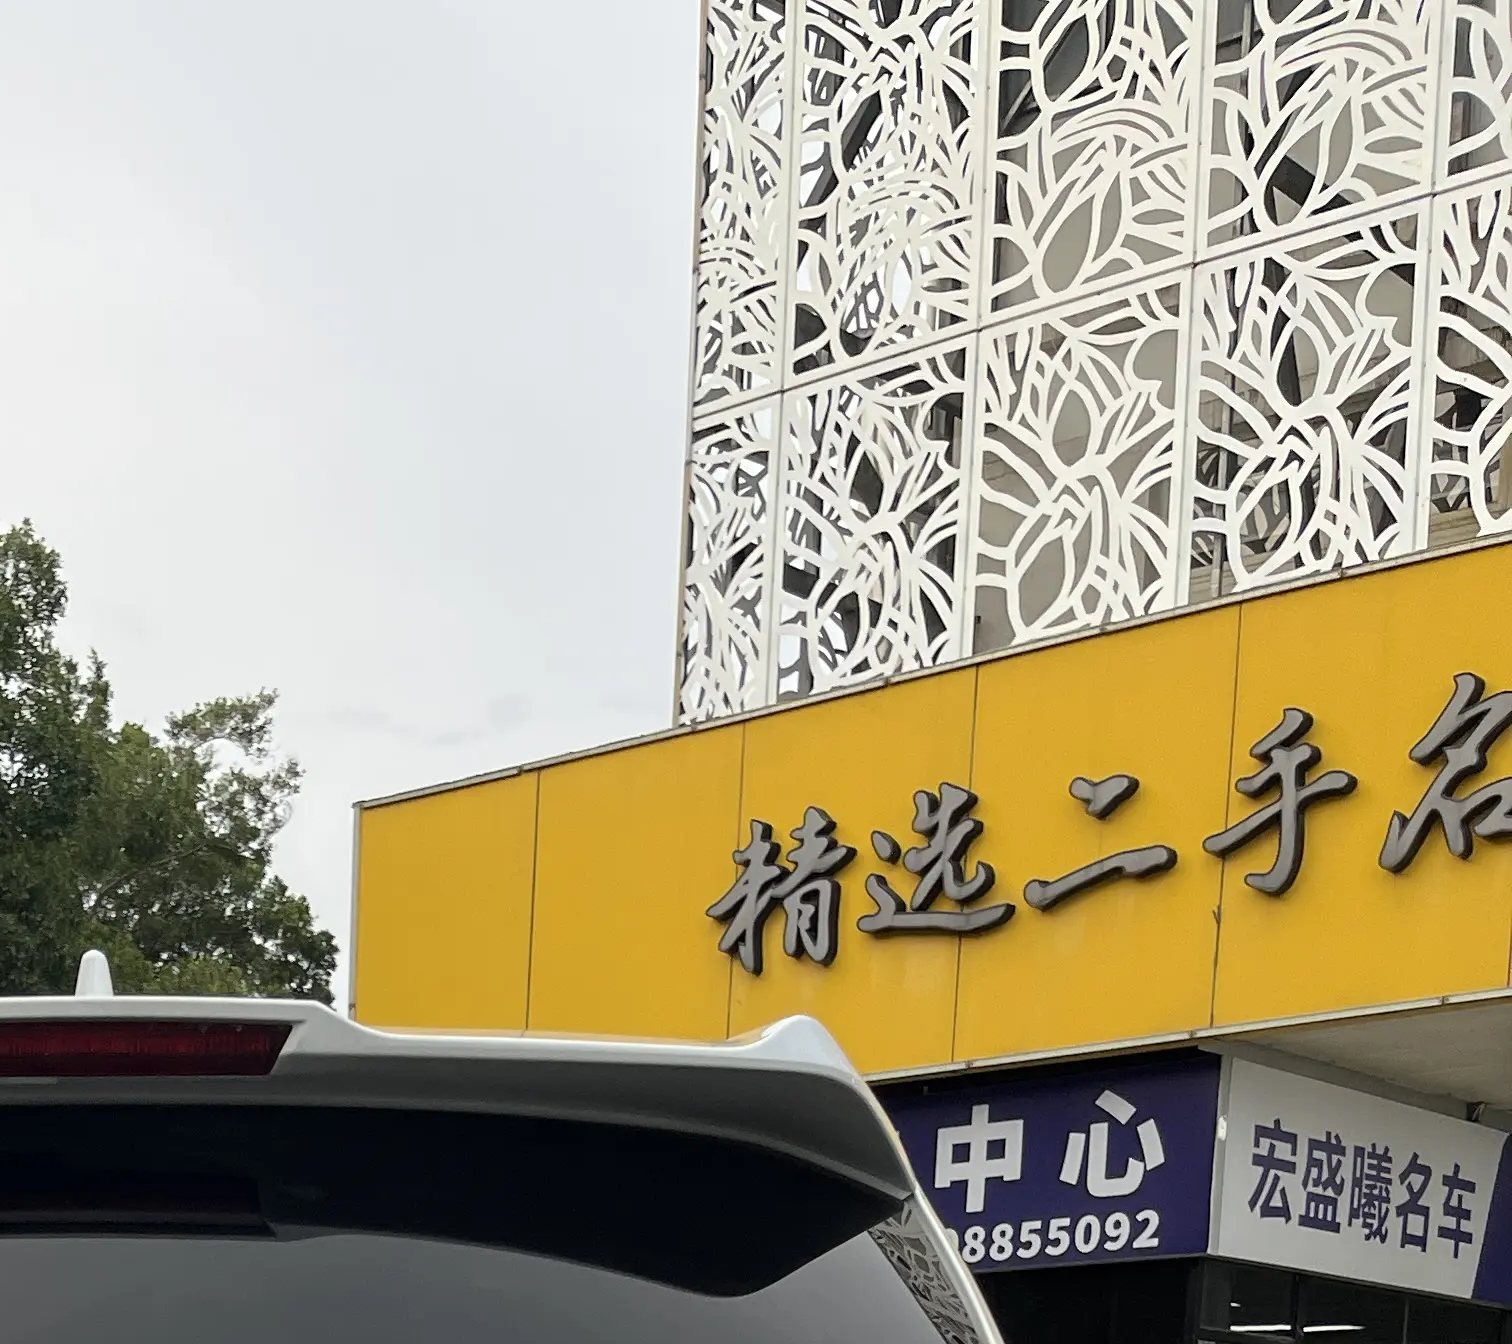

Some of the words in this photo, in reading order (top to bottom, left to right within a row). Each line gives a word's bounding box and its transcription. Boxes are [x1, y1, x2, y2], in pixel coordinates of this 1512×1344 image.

[707, 671, 1512, 976] 精选二手名
[933, 1089, 1167, 1213] 中心
[1247, 1117, 1478, 1260] 宏盛曦名车
